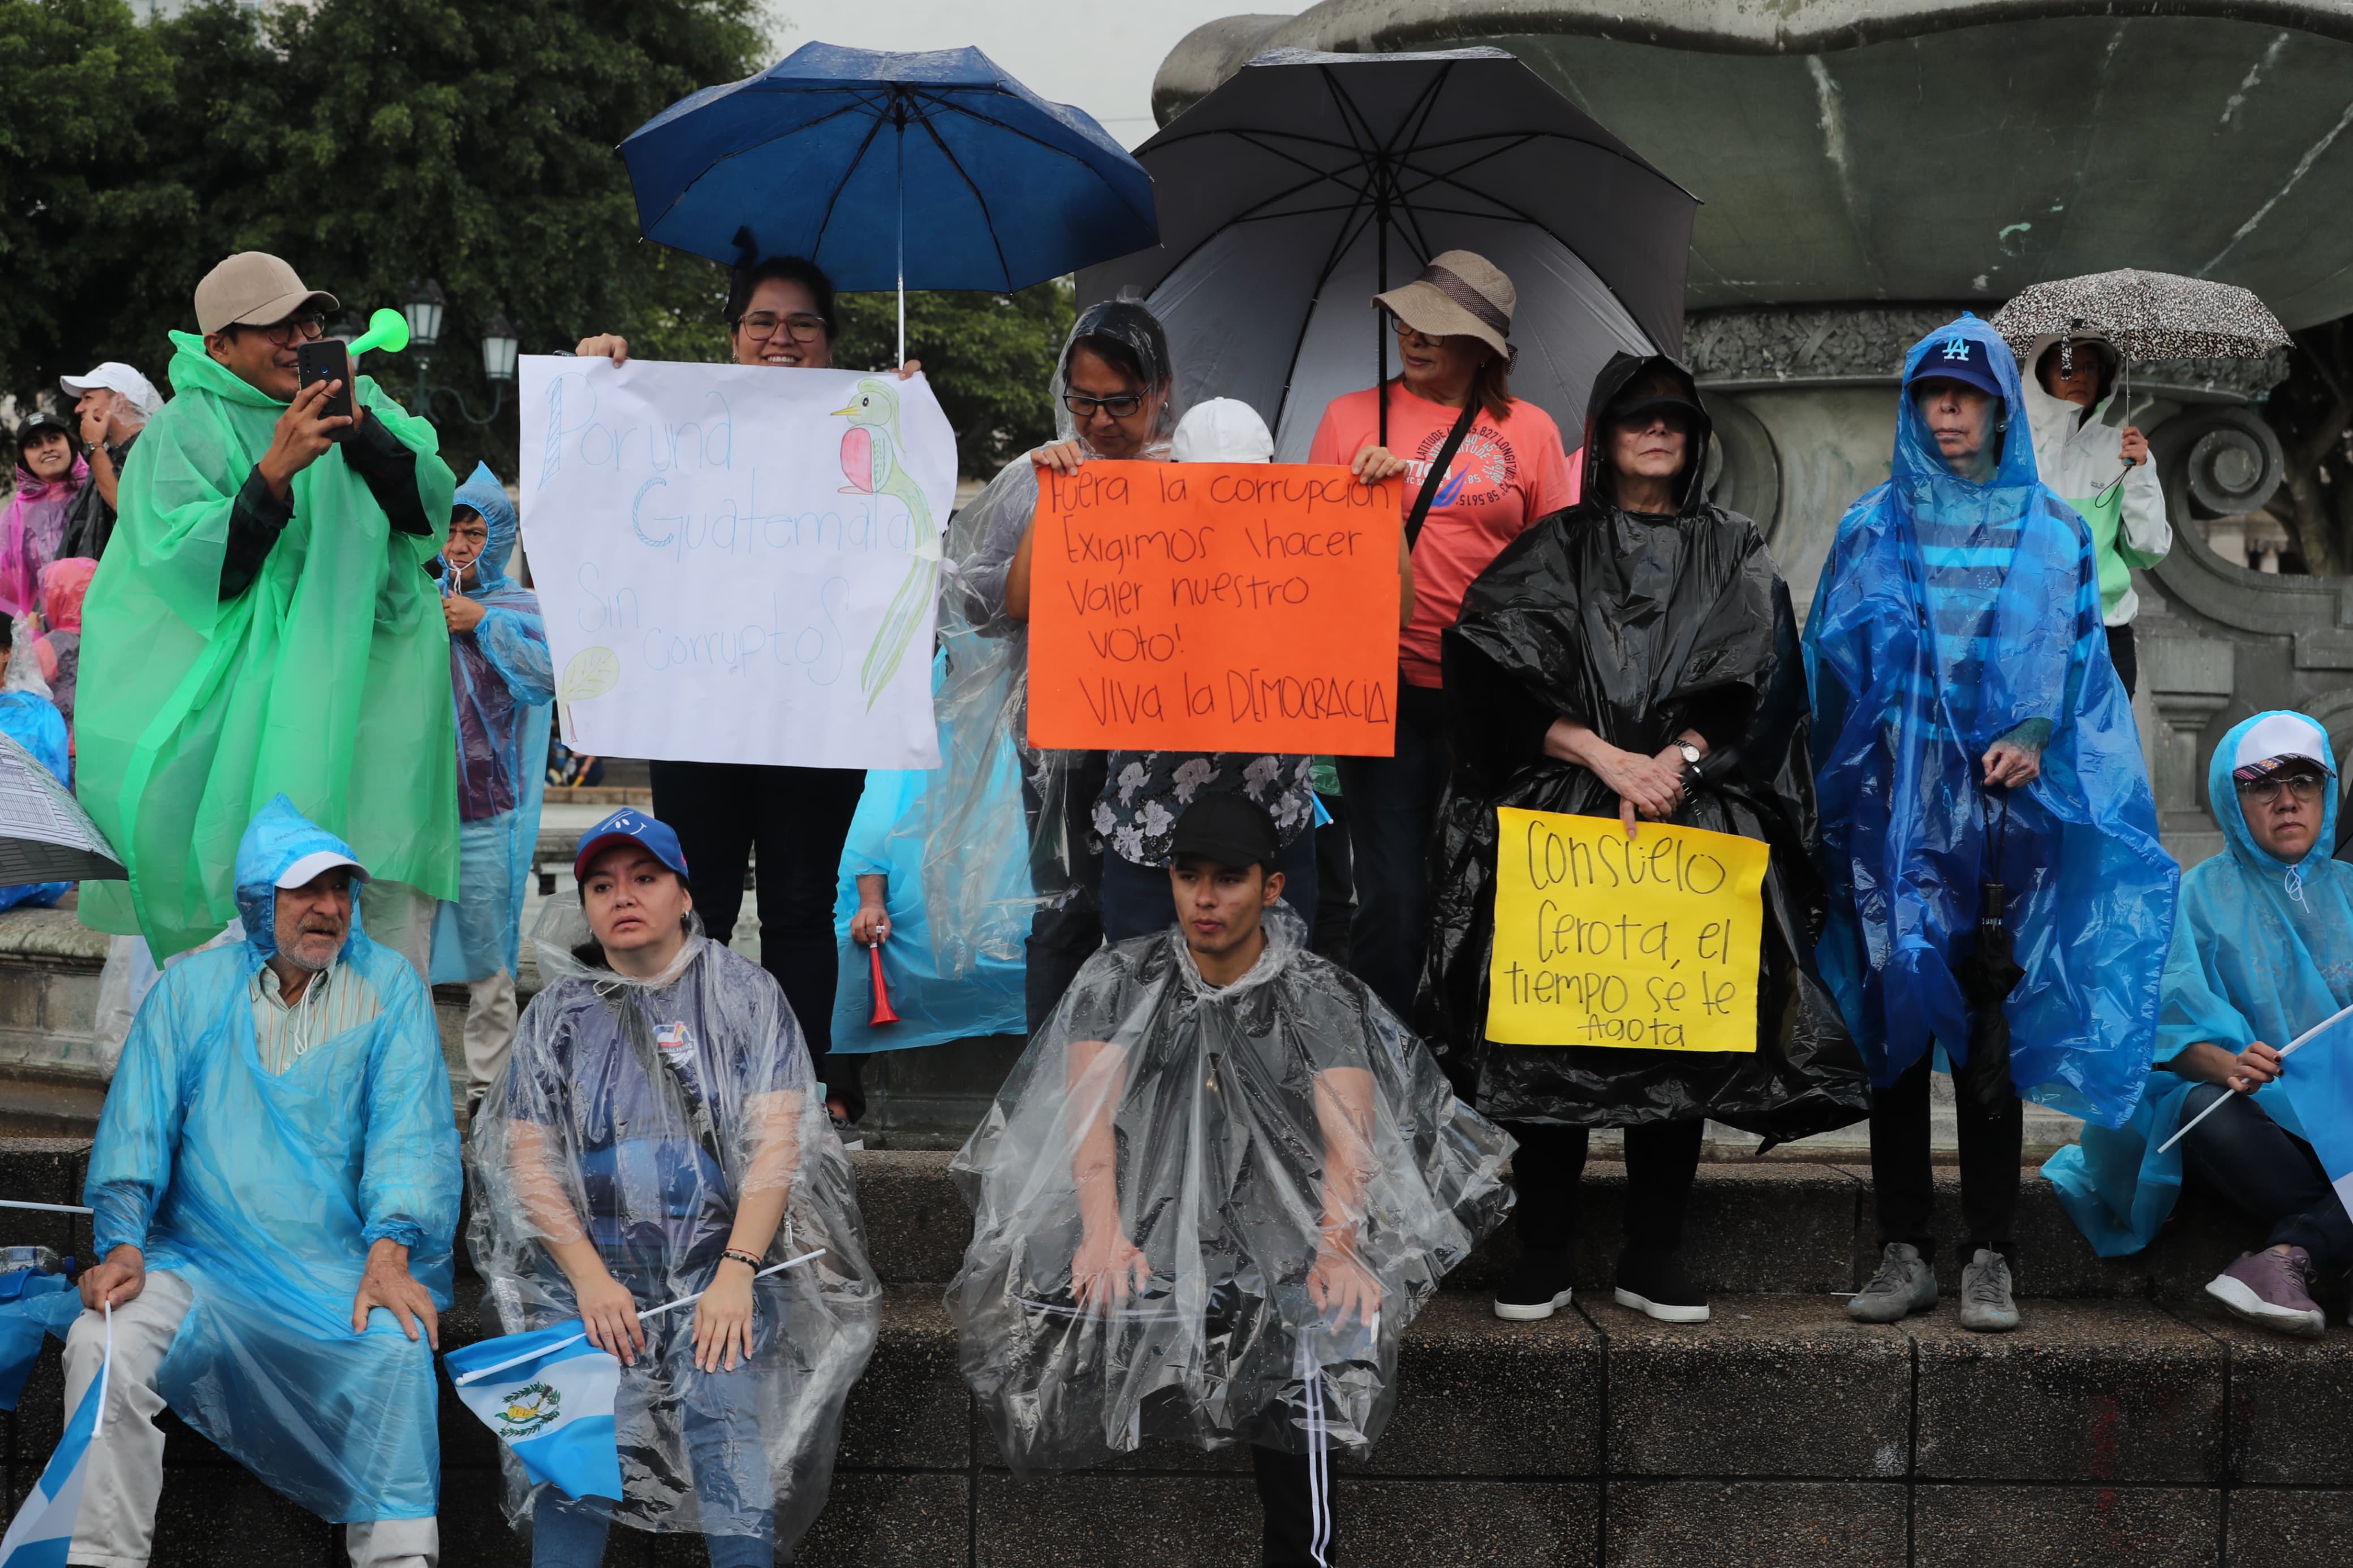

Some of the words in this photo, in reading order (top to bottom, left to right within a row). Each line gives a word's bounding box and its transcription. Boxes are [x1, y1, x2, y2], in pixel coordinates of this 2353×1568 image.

[1942, 338, 1970, 361] LA
[538, 372, 639, 490] Por
[650, 391, 732, 472] una
[1415, 429, 1446, 460] LATITUDE
[1158, 467, 1187, 504] la
[632, 467, 911, 563] Guatemala
[1062, 515, 1214, 574] Exigimos
[578, 562, 639, 633] Sin
[1173, 572, 1309, 609] nuestro
[1184, 672, 1215, 718] la
[1527, 819, 1726, 895] Consuelo
[1697, 918, 1731, 965] el
[1503, 961, 1628, 1014] tiempo
